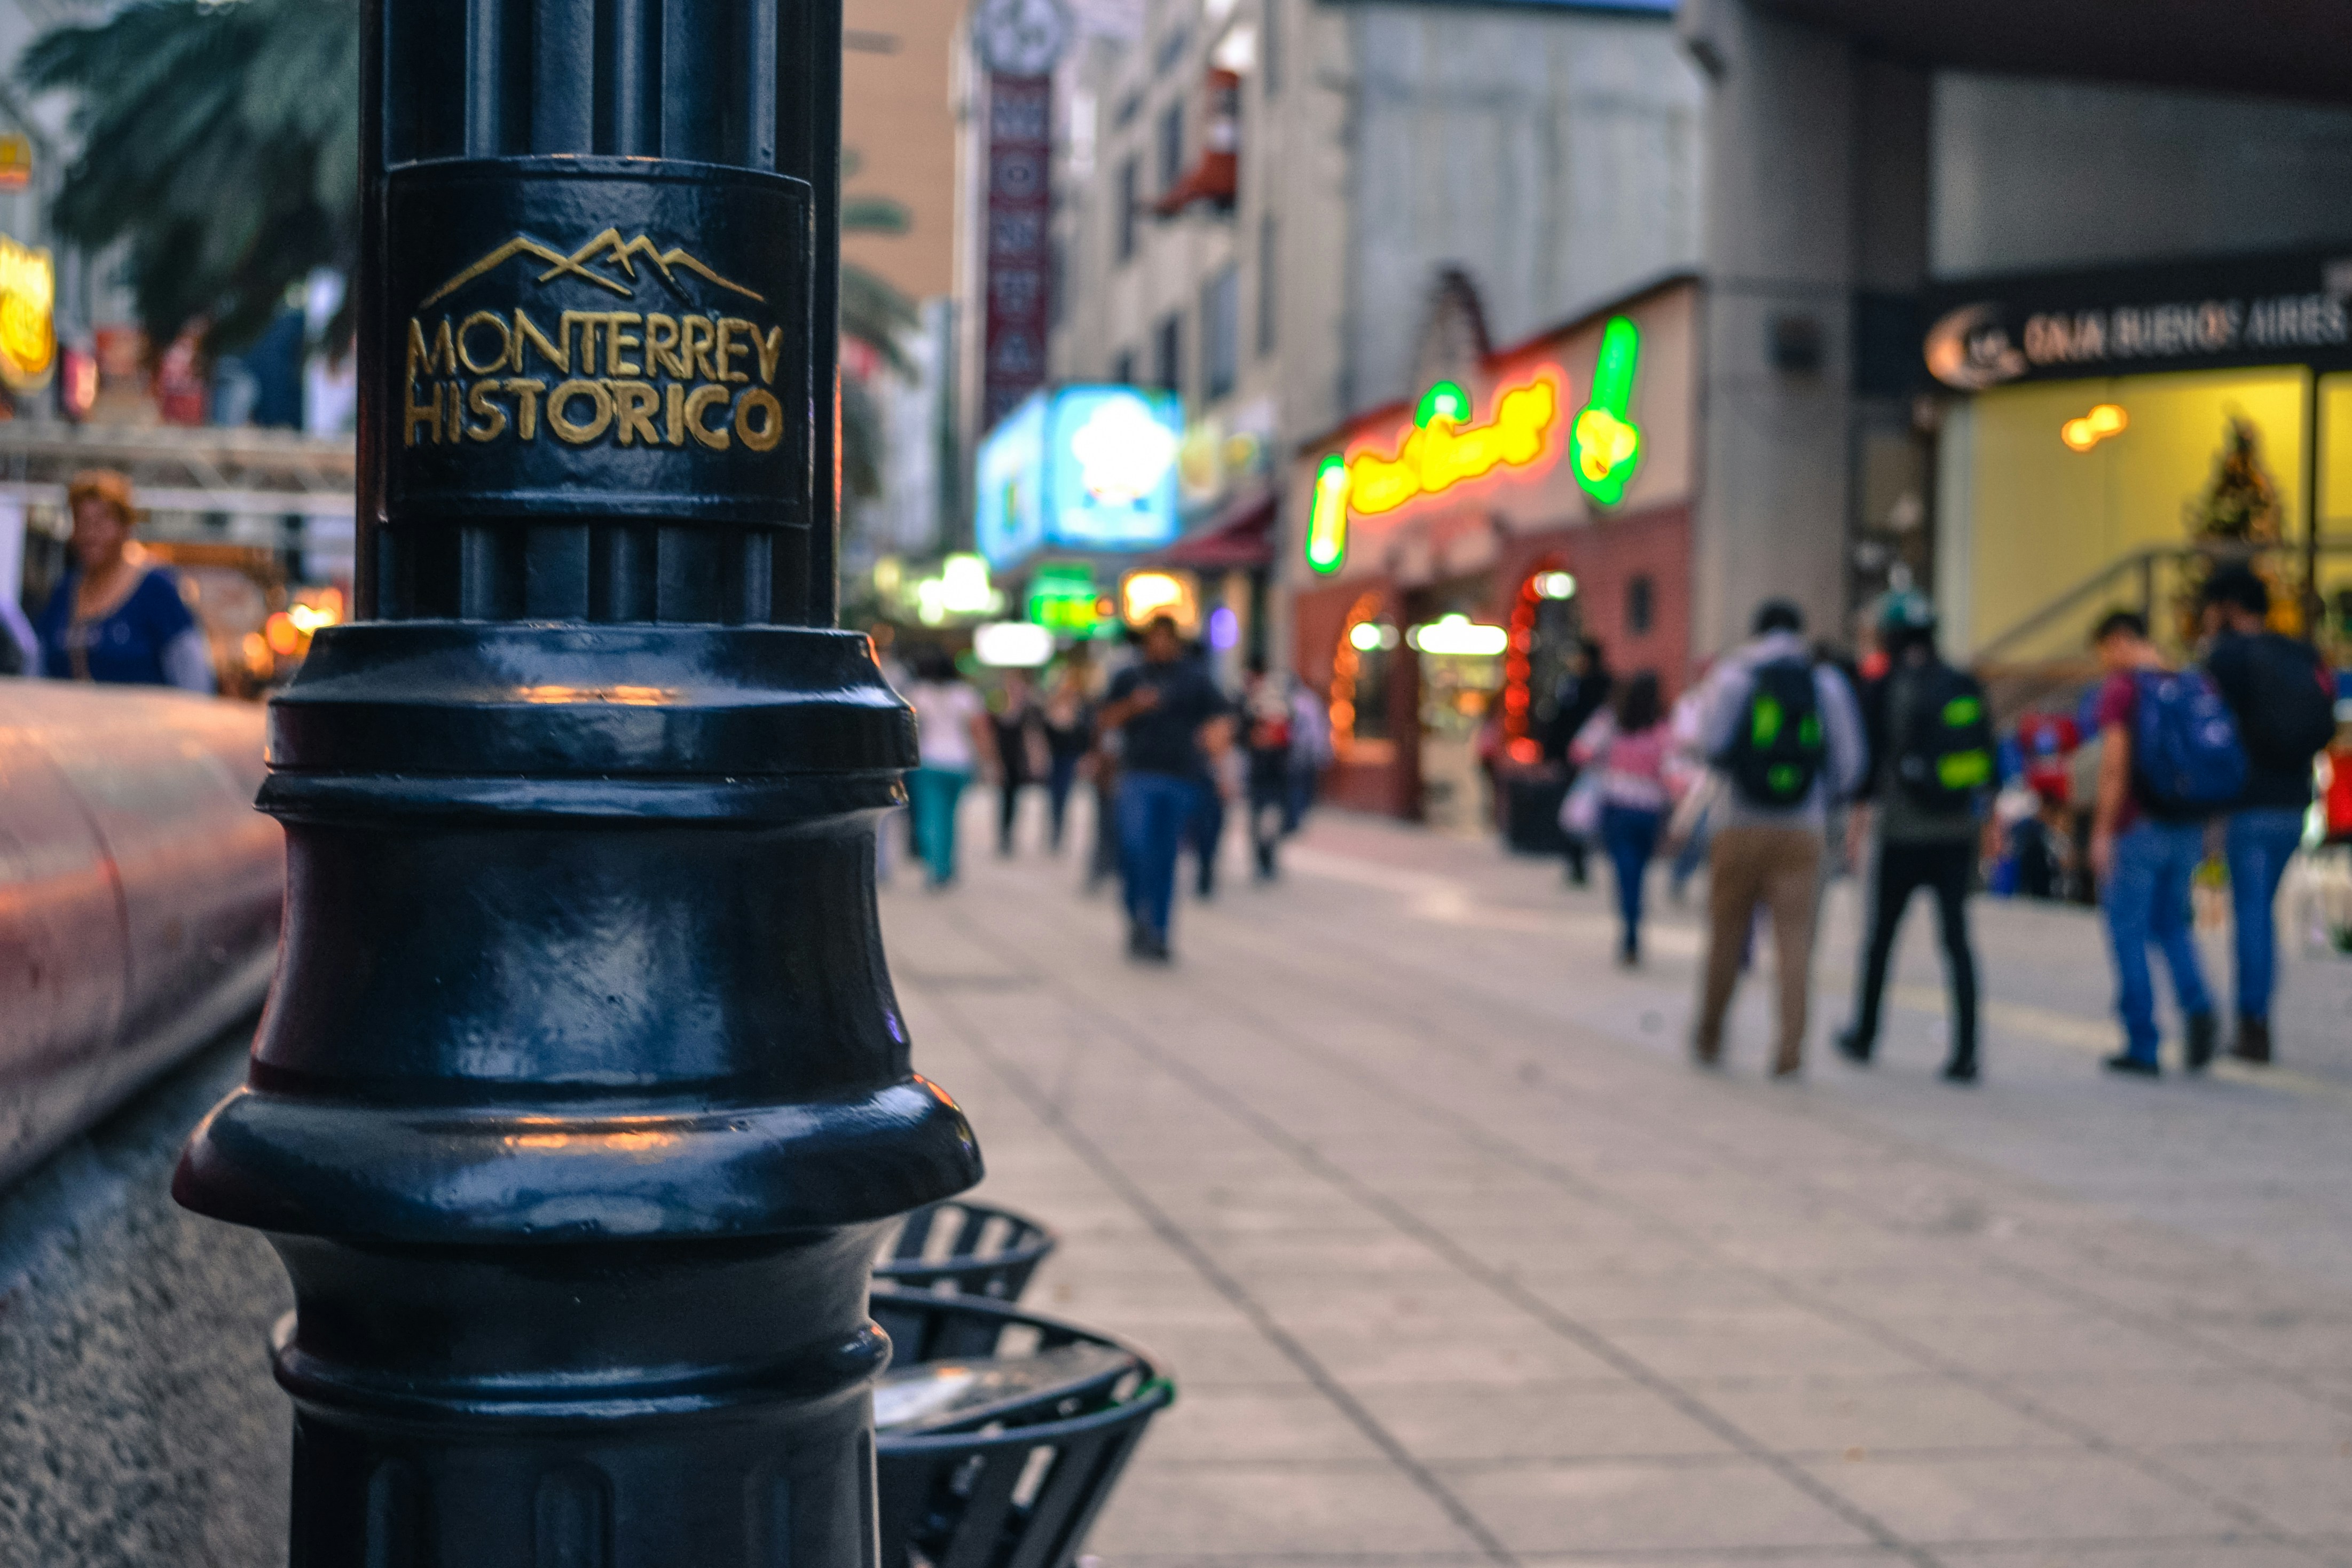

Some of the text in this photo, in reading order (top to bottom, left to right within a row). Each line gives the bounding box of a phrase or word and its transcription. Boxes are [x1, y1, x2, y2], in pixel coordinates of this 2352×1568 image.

[408, 309, 782, 383] MONTERREY
[2109, 298, 2244, 359] BUENOS
[403, 379, 783, 452] HISTORICO
